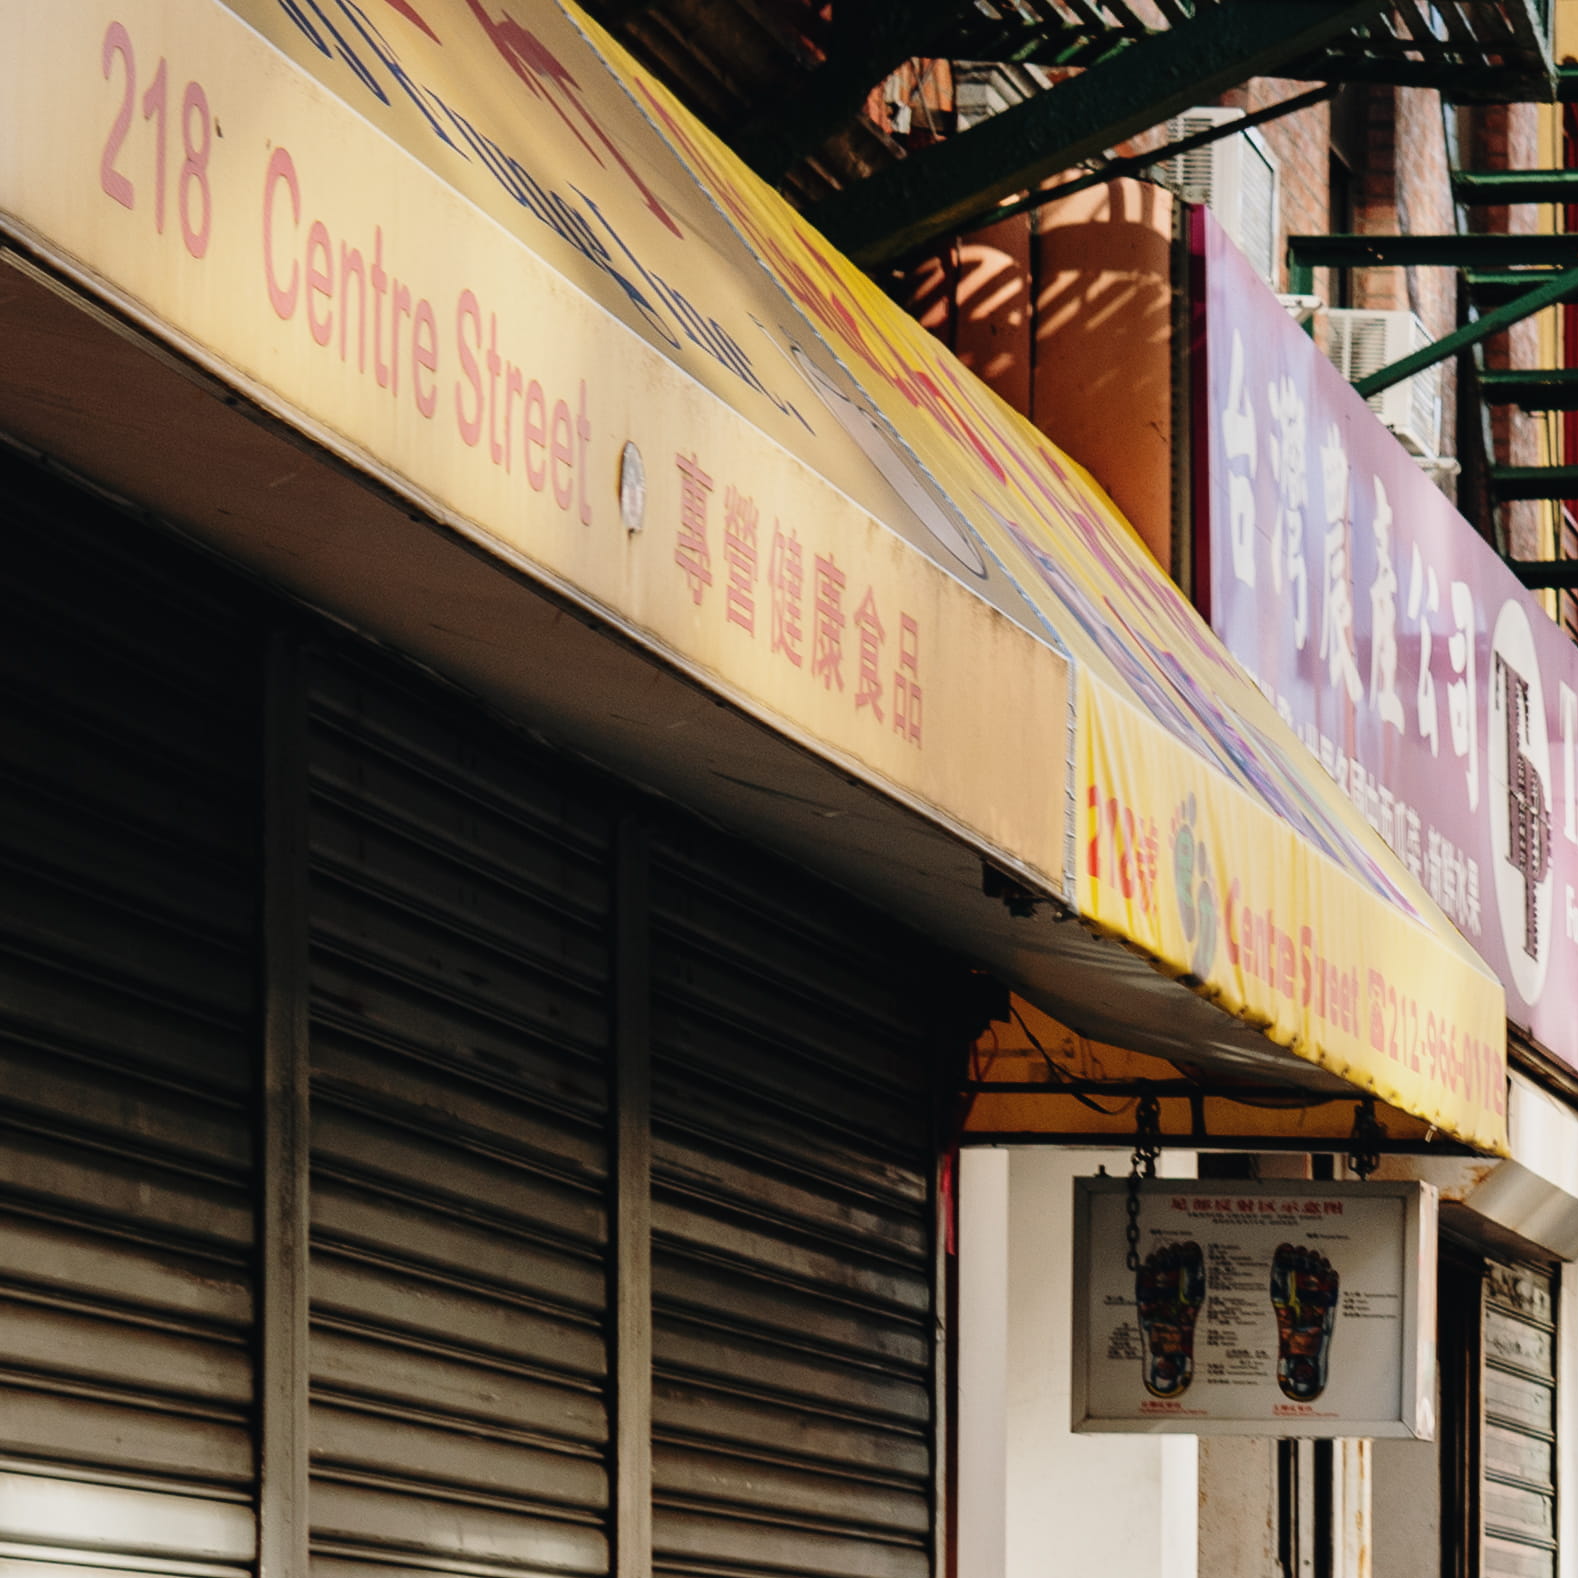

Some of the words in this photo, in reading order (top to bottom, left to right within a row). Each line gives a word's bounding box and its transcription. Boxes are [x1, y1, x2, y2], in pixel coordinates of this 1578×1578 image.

[100, 20, 213, 260] 218
[262, 147, 438, 419] Centre
[455, 289, 594, 526] Street
[675, 452, 925, 752] 專營健康食品
[1226, 879, 1297, 1001] Centre
[1300, 925, 1360, 1039] Street
